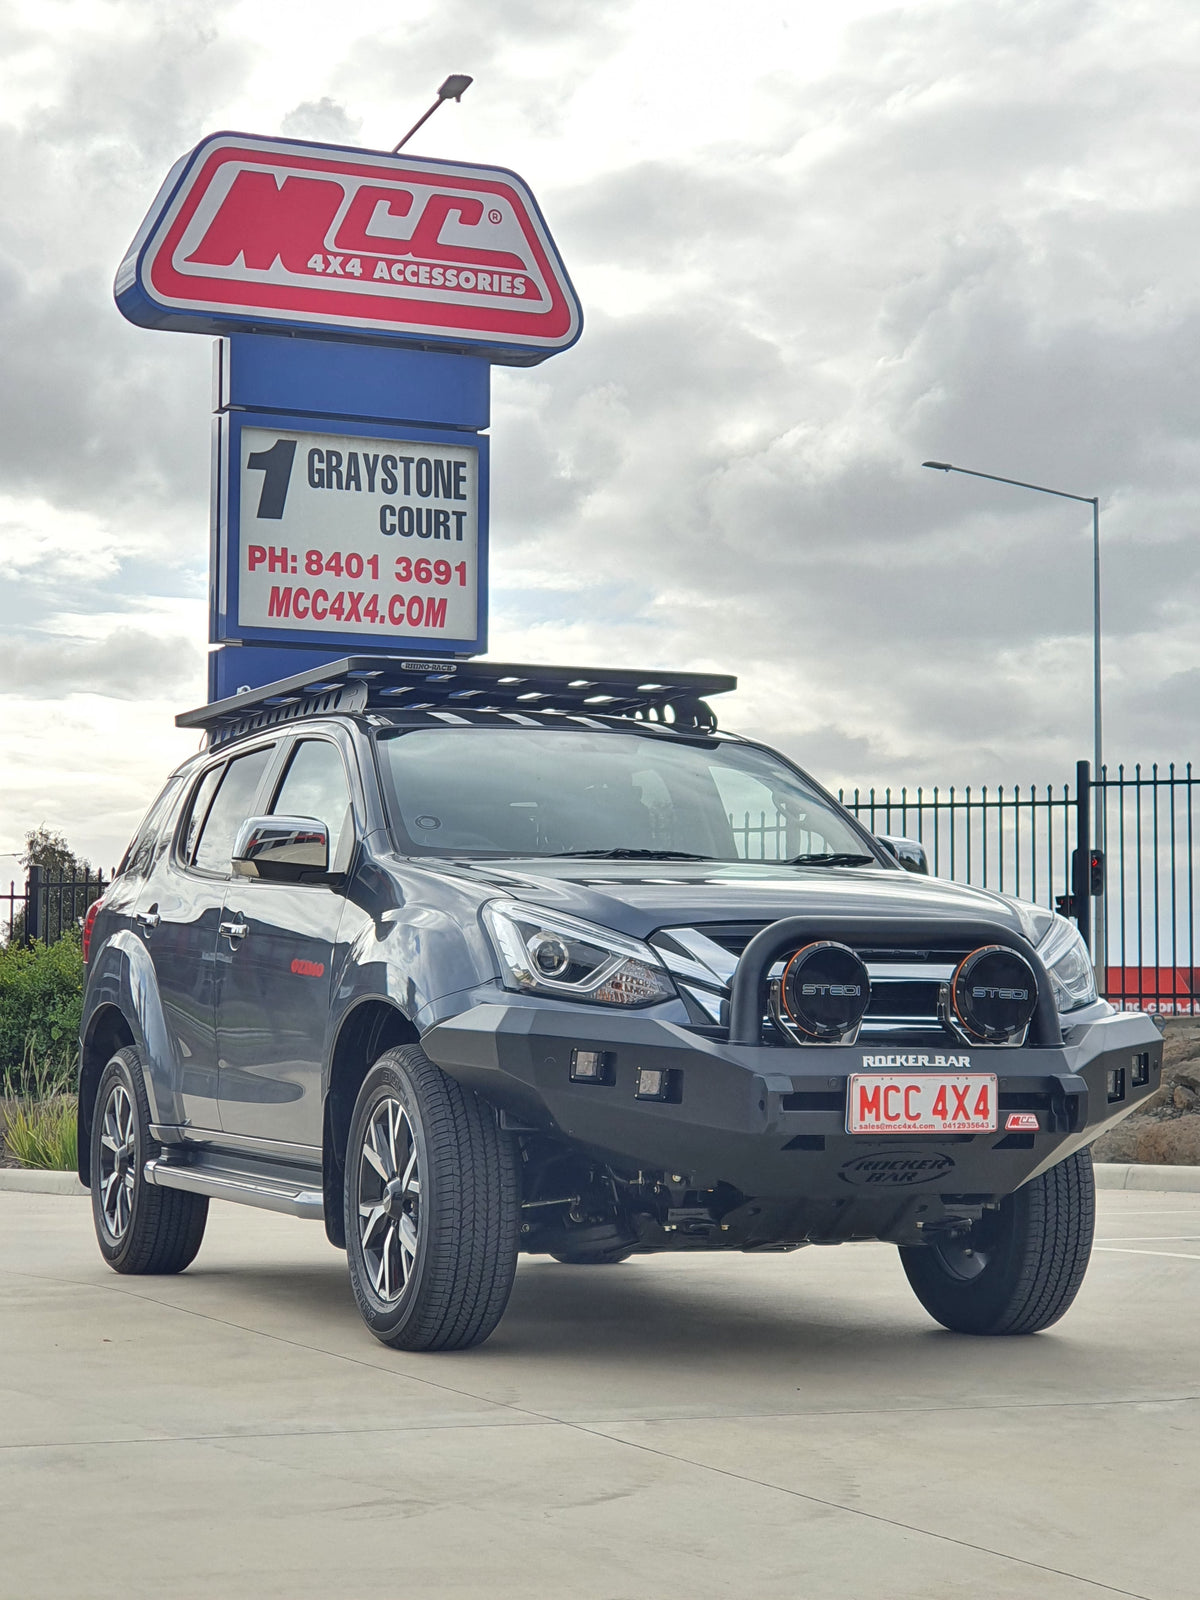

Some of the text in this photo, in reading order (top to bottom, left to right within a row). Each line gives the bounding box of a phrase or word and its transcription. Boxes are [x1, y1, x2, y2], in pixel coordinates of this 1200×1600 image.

[184, 170, 528, 273] MCC
[307, 252, 526, 296] 4X4 ACCESSORIES
[247, 439, 467, 520] 1 GRAYSTONE
[379, 504, 467, 541] COURT
[248, 544, 467, 587] PH: 8401 3691
[268, 586, 448, 628] MCC4X4.COM
[802, 984, 861, 996] STEDI
[972, 986, 1028, 1000] STEDI
[862, 1055, 971, 1067] ROCKER BAR
[859, 1084, 990, 1122] MCC 4X4
[859, 1122, 936, 1130] sales@mcc4x4.com
